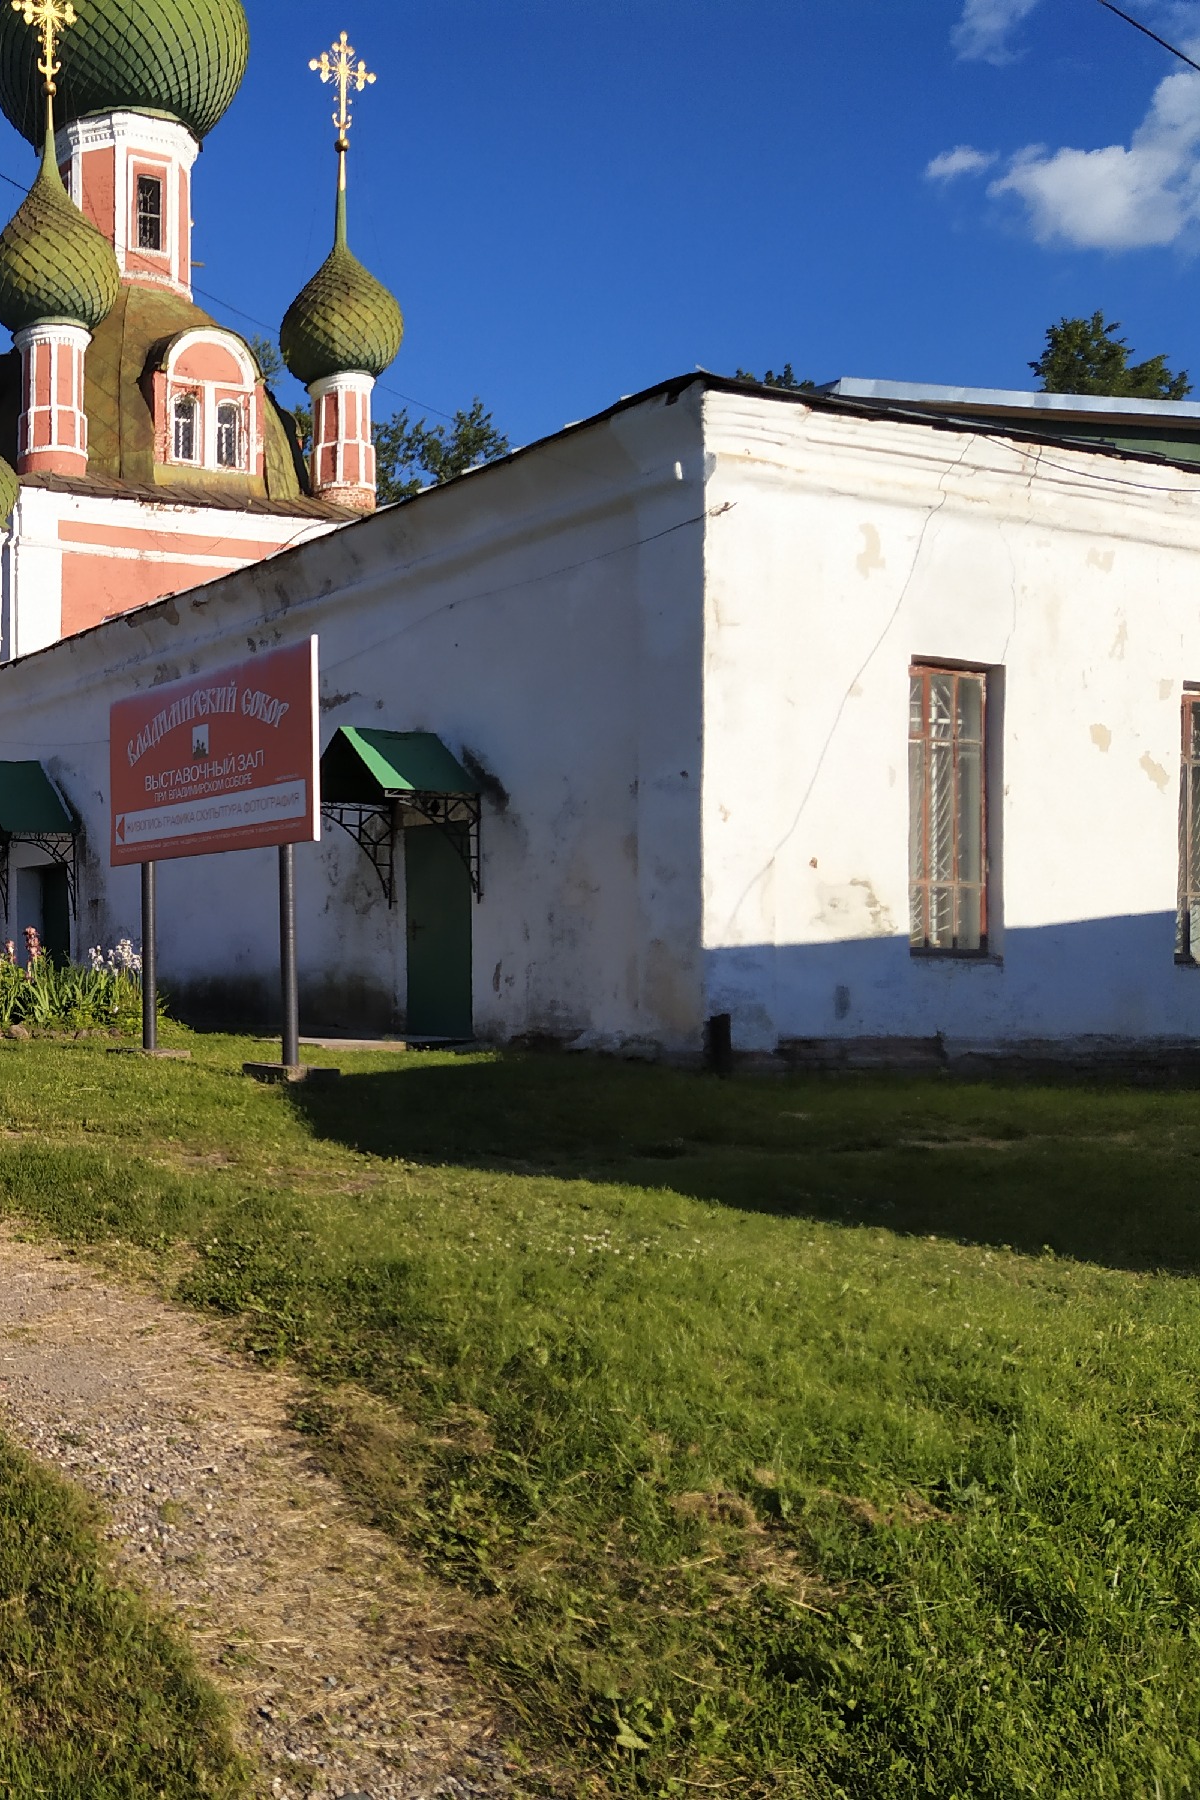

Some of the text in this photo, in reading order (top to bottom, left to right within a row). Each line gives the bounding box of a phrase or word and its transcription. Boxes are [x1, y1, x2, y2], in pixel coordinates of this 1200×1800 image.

[241, 688, 289, 728] СОБОР
[144, 749, 264, 792] ВЫСТАВОЧНЫЙ ЗАЛ
[154, 791, 167, 803] ПРИ
[168, 780, 224, 800] ВЛАДИМИРСКОМ
[225, 772, 253, 789] СОБОРЕ
[126, 792, 300, 833] ЖИВОПИСЬ ГРАФИКА СКУЛЬПТУРА ФОТОГРАФИЯ
